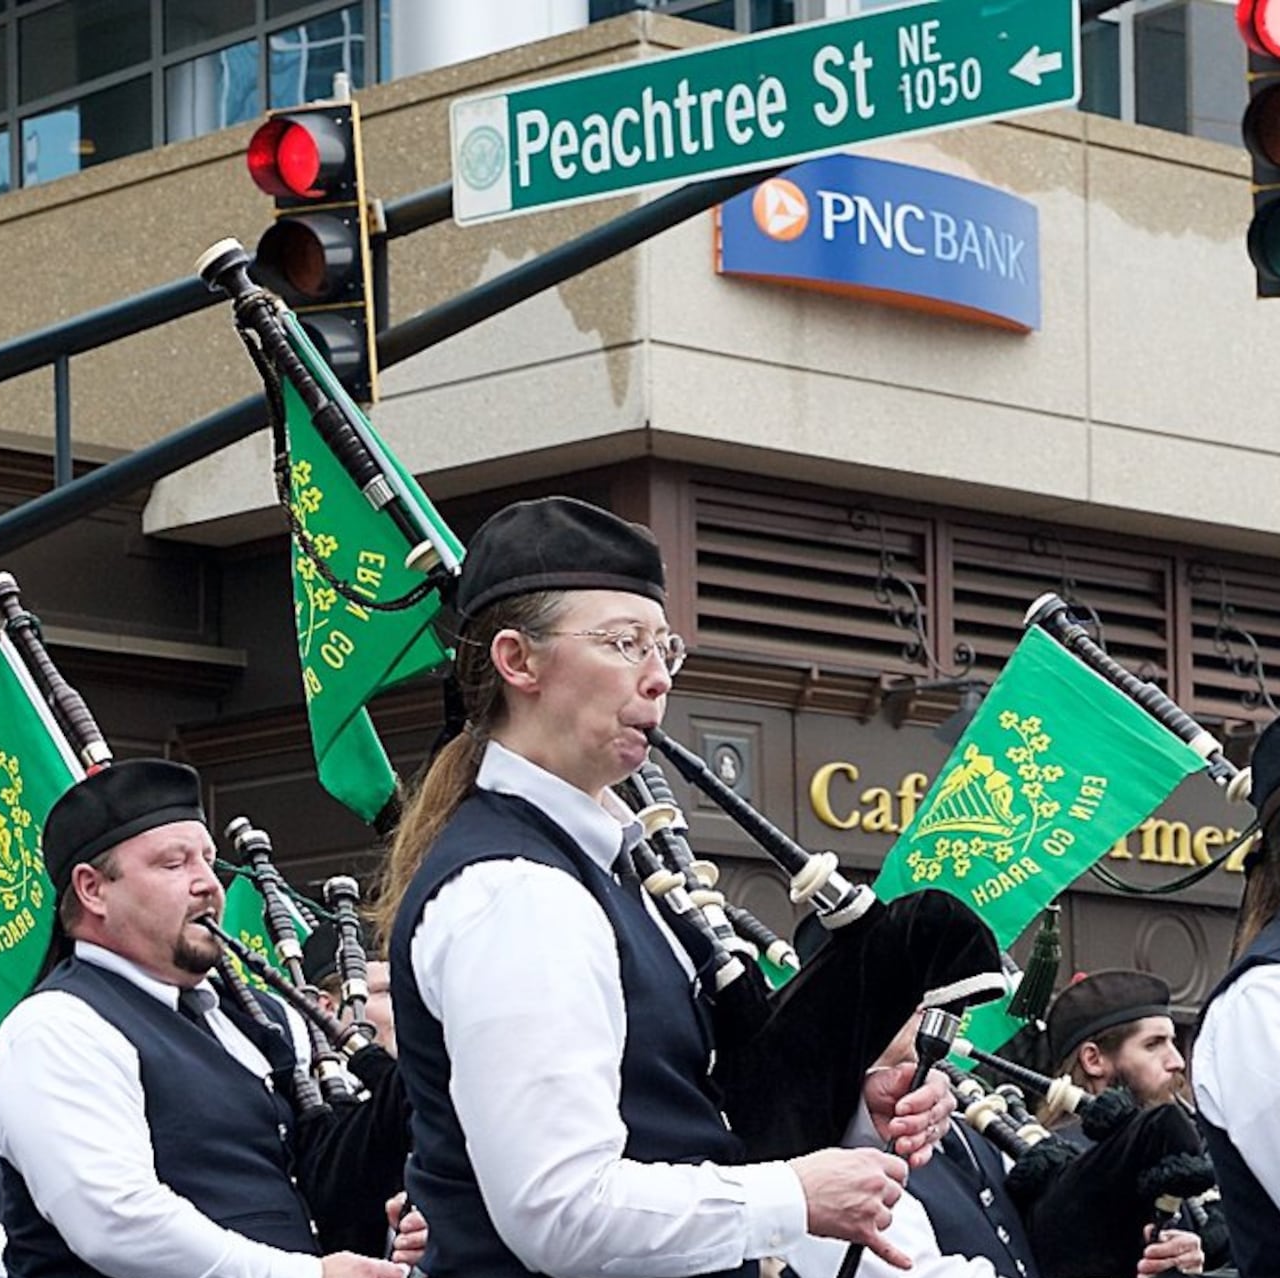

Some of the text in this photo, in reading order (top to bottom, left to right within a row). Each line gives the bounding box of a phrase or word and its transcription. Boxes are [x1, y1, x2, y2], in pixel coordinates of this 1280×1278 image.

[898, 20, 941, 68] NE
[515, 41, 874, 188] Peachtree St
[900, 58, 982, 114] 1050
[816, 190, 1028, 284] PNC BANK
[809, 762, 927, 834] Caf
